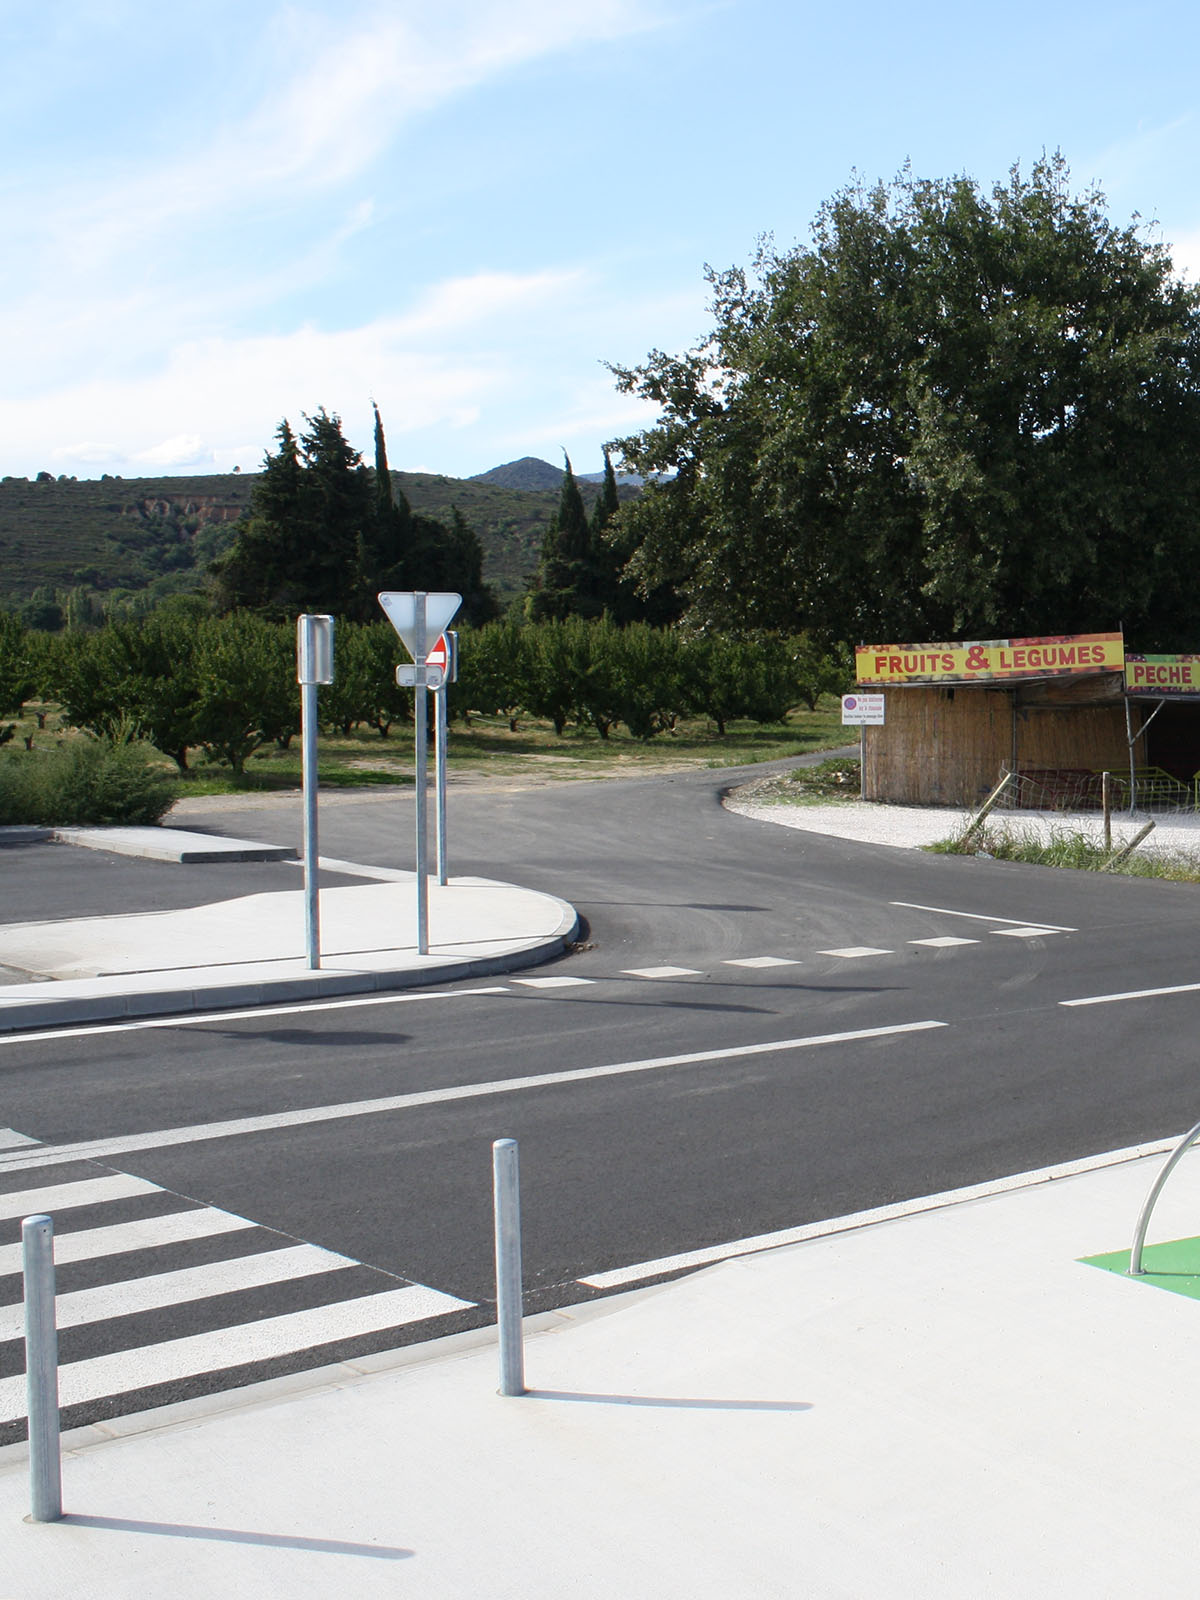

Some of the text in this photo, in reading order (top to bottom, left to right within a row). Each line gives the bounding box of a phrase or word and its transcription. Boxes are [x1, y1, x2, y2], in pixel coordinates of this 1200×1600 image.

[875, 645, 1106, 674] FRUITS & LEGUMES
[1134, 666, 1192, 683] PECHE
